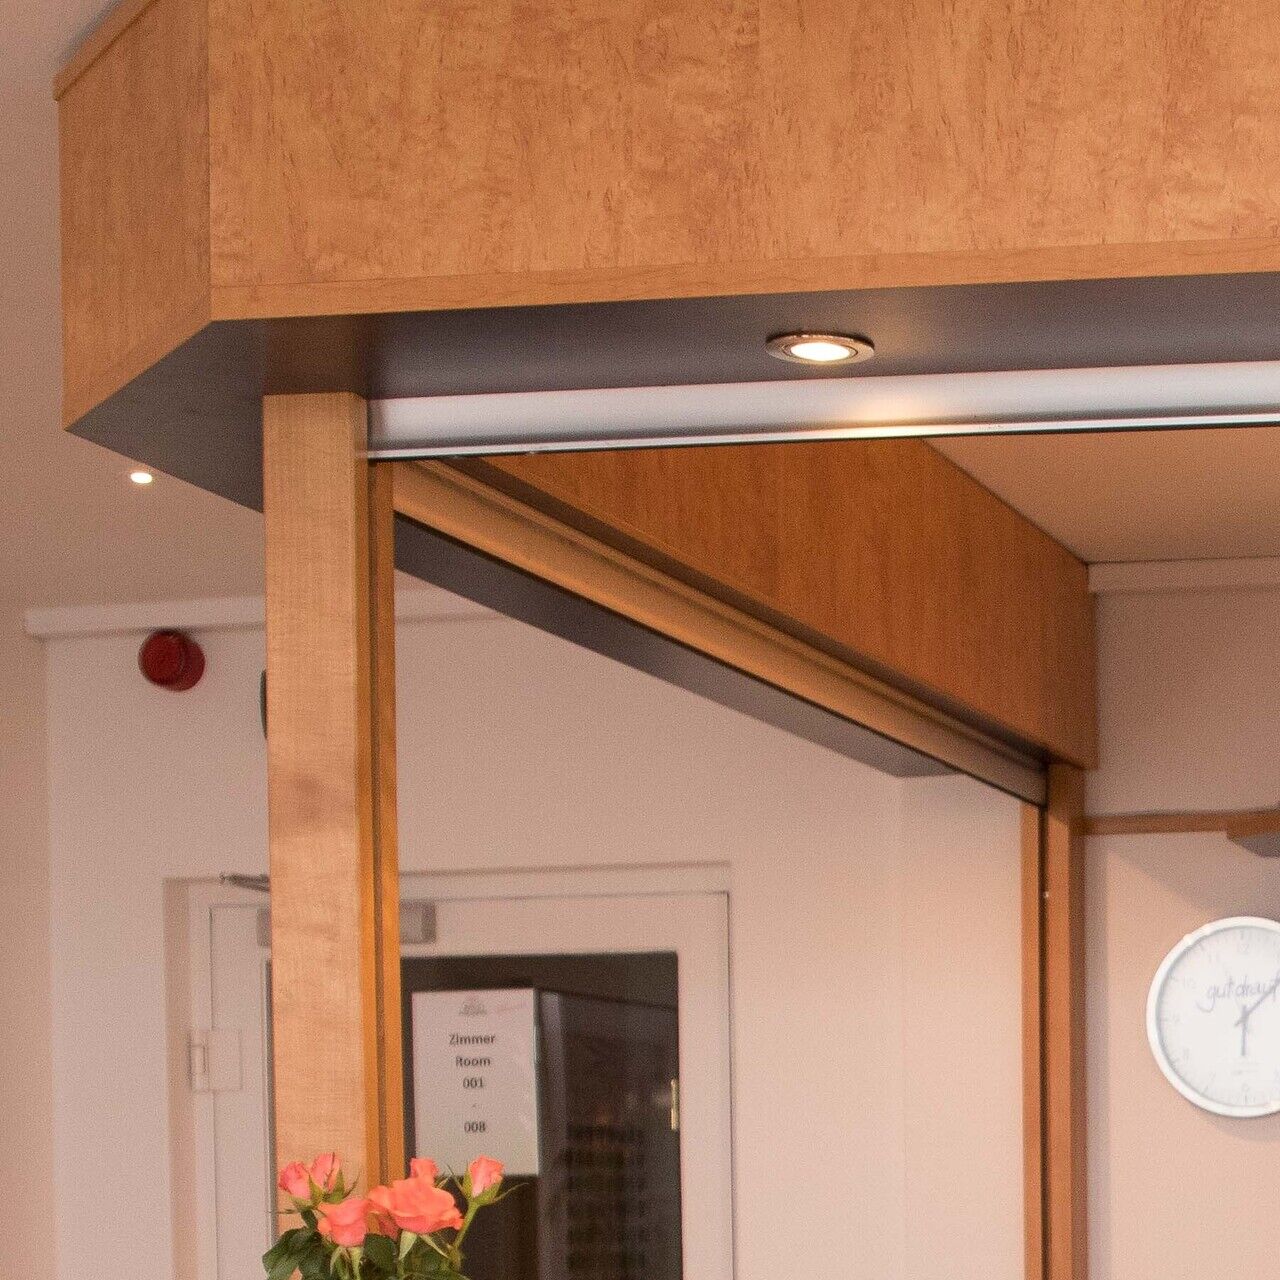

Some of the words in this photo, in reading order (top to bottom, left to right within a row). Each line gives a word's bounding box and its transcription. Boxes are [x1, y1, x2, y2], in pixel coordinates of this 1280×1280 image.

[449, 1033, 496, 1046] Zimmer
[455, 1056, 491, 1067] Room
[462, 1077, 484, 1089] 001
[464, 1121, 486, 1133] 008
